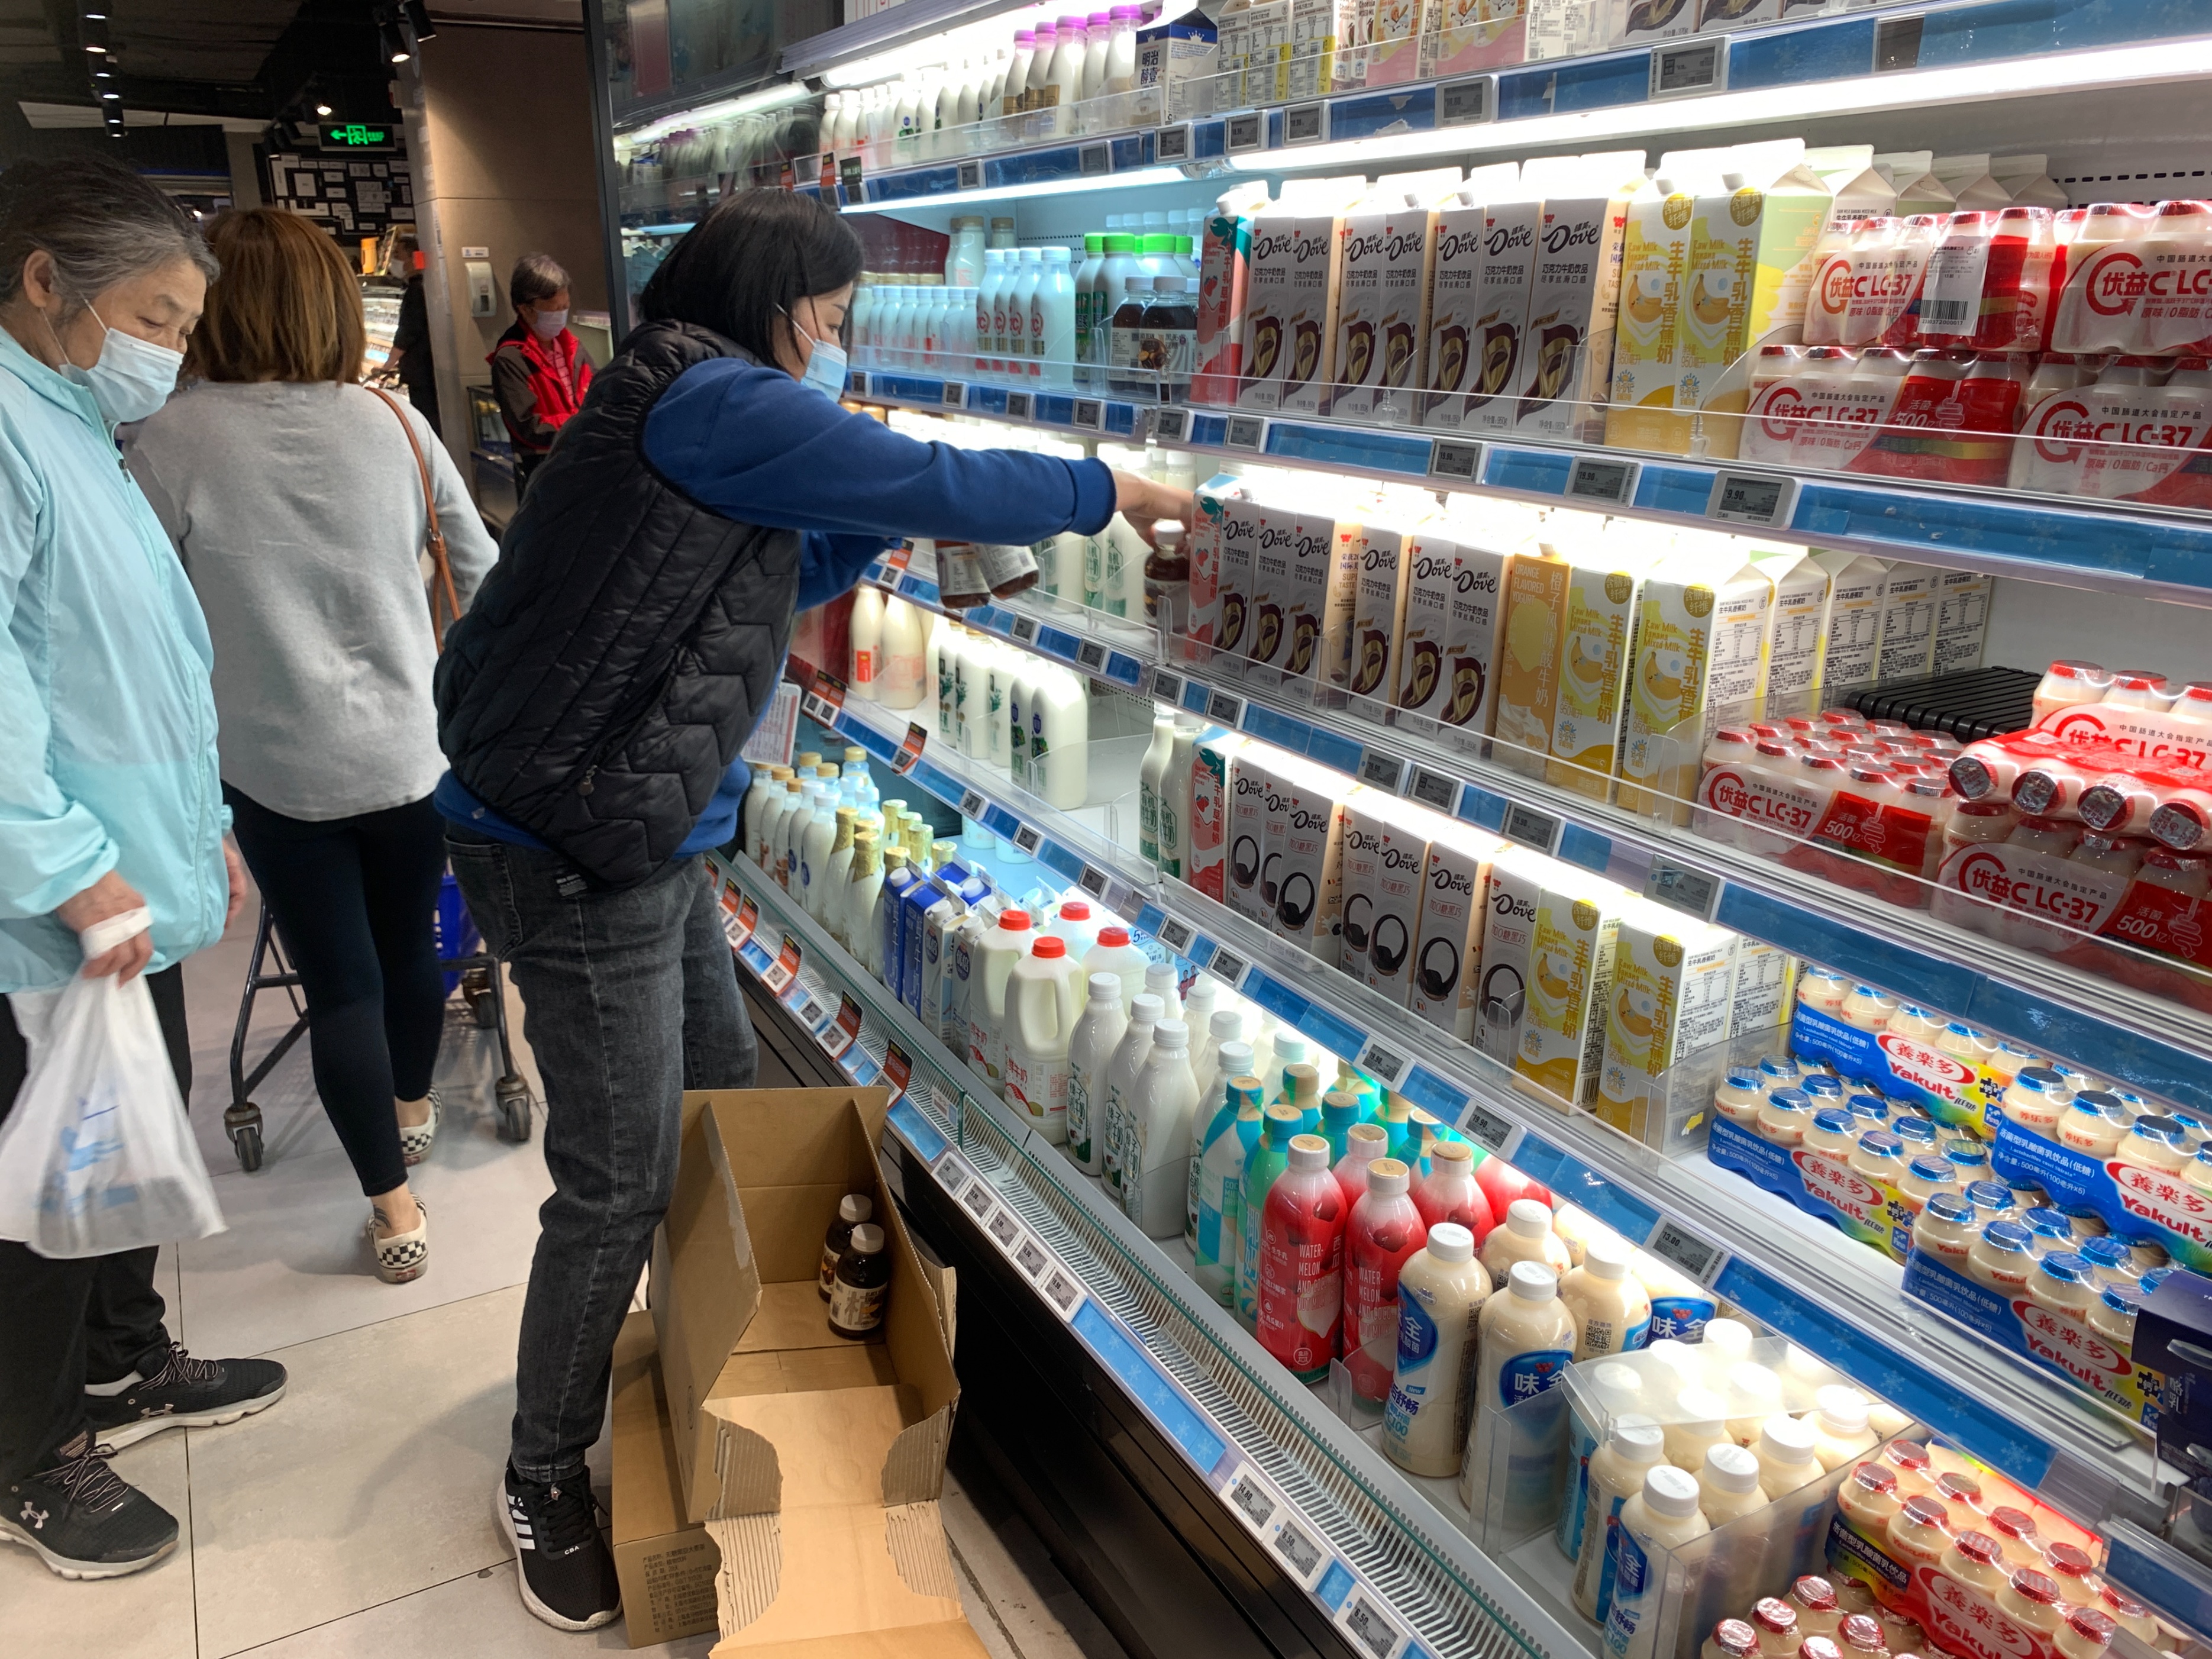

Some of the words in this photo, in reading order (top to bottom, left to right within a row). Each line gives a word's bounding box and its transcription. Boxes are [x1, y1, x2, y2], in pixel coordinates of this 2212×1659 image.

[1142, 50, 1158, 66] 明治
[1253, 237, 1291, 260] Dove
[1345, 238, 1383, 262] Dove
[1385, 235, 1422, 261] Dove
[1438, 235, 1478, 261] Dove
[1484, 228, 1533, 256] Dove
[1542, 225, 1598, 253] Dove
[1293, 239, 1329, 263] Dove
[1830, 276, 1866, 298] 优益C
[1871, 274, 1913, 297] LC-37
[2103, 271, 2171, 296] 优益C
[1656, 241, 1684, 364] 生牛乳香蕉奶
[1723, 239, 1753, 366] 生牛乳香蕉奶
[2141, 308, 2163, 318] 原味
[2169, 308, 2200, 318] 0脂肪
[1811, 392, 1885, 403] 中国肠道大会指定产品
[1826, 407, 1878, 431] LC-37
[2101, 406, 2201, 419] 中国肠道大会指定产品
[2050, 420, 2114, 447] 优益C
[2121, 423, 2193, 449] LC-37
[2085, 458, 2107, 469] 原味
[2113, 459, 2140, 470] 0脂肪
[2146, 461, 2169, 473] Ca钙
[1223, 521, 1254, 540] Dove
[1259, 529, 1292, 549] Dove
[1295, 537, 1329, 557] Dove
[1361, 550, 1396, 571] Dove
[1413, 557, 1452, 580] Dove
[1516, 564, 1539, 579] ORANGE
[1453, 570, 1496, 593] Dove
[1514, 579, 1544, 594] FLAVORED
[1513, 590, 1535, 605] YOGURT
[1535, 570, 1563, 708] 橙子风味酸牛奶
[1597, 614, 1623, 724] 生牛乳香蕉奶
[1234, 778, 1263, 798] Dove
[1752, 783, 1817, 808] 中国肠道大会指定产品
[1720, 785, 1762, 815] 优益C
[1765, 795, 1812, 829] LC-37
[1839, 812, 1856, 824] 活菌
[1290, 811, 1327, 833] Dove
[1345, 831, 1380, 854] Dove
[1381, 849, 1420, 874] Dove
[1430, 869, 1471, 896] Dove
[2018, 868, 2107, 899] 中国肠道大会指定产品
[1972, 868, 2030, 905] 优益C
[2035, 885, 2100, 924] LC-37
[1491, 894, 1535, 922] Dove
[2136, 906, 2163, 921] 活菌
[1687, 954, 1715, 967] 生牛乳香蕉奶
[1562, 938, 1590, 1040] 生牛乳香蕉奶
[1646, 975, 1674, 1078] 生牛乳香蕉奶
[1889, 1061, 1955, 1100] Yakult
[1107, 1105, 1121, 1125] 榛子
[2020, 1111, 2054, 1124] 养乐多
[2065, 1131, 2094, 1147] 养乐多
[1804, 1178, 1865, 1221] Yakult
[2121, 1193, 2207, 1242] Yakult
[1662, 1232, 1680, 1246] 13.00
[1299, 1244, 1323, 1258] WATER-
[1299, 1261, 1320, 1276] MELON
[1297, 1279, 1312, 1293] AND
[1358, 1287, 1380, 1302] MELON
[1297, 1297, 1310, 1311] NUT
[2026, 1332, 2108, 1391] Yakult
[1238, 1484, 1252, 1500] 14.80
[1282, 1531, 1295, 1547] 6.50
[1354, 1608, 1368, 1625] 6.50
